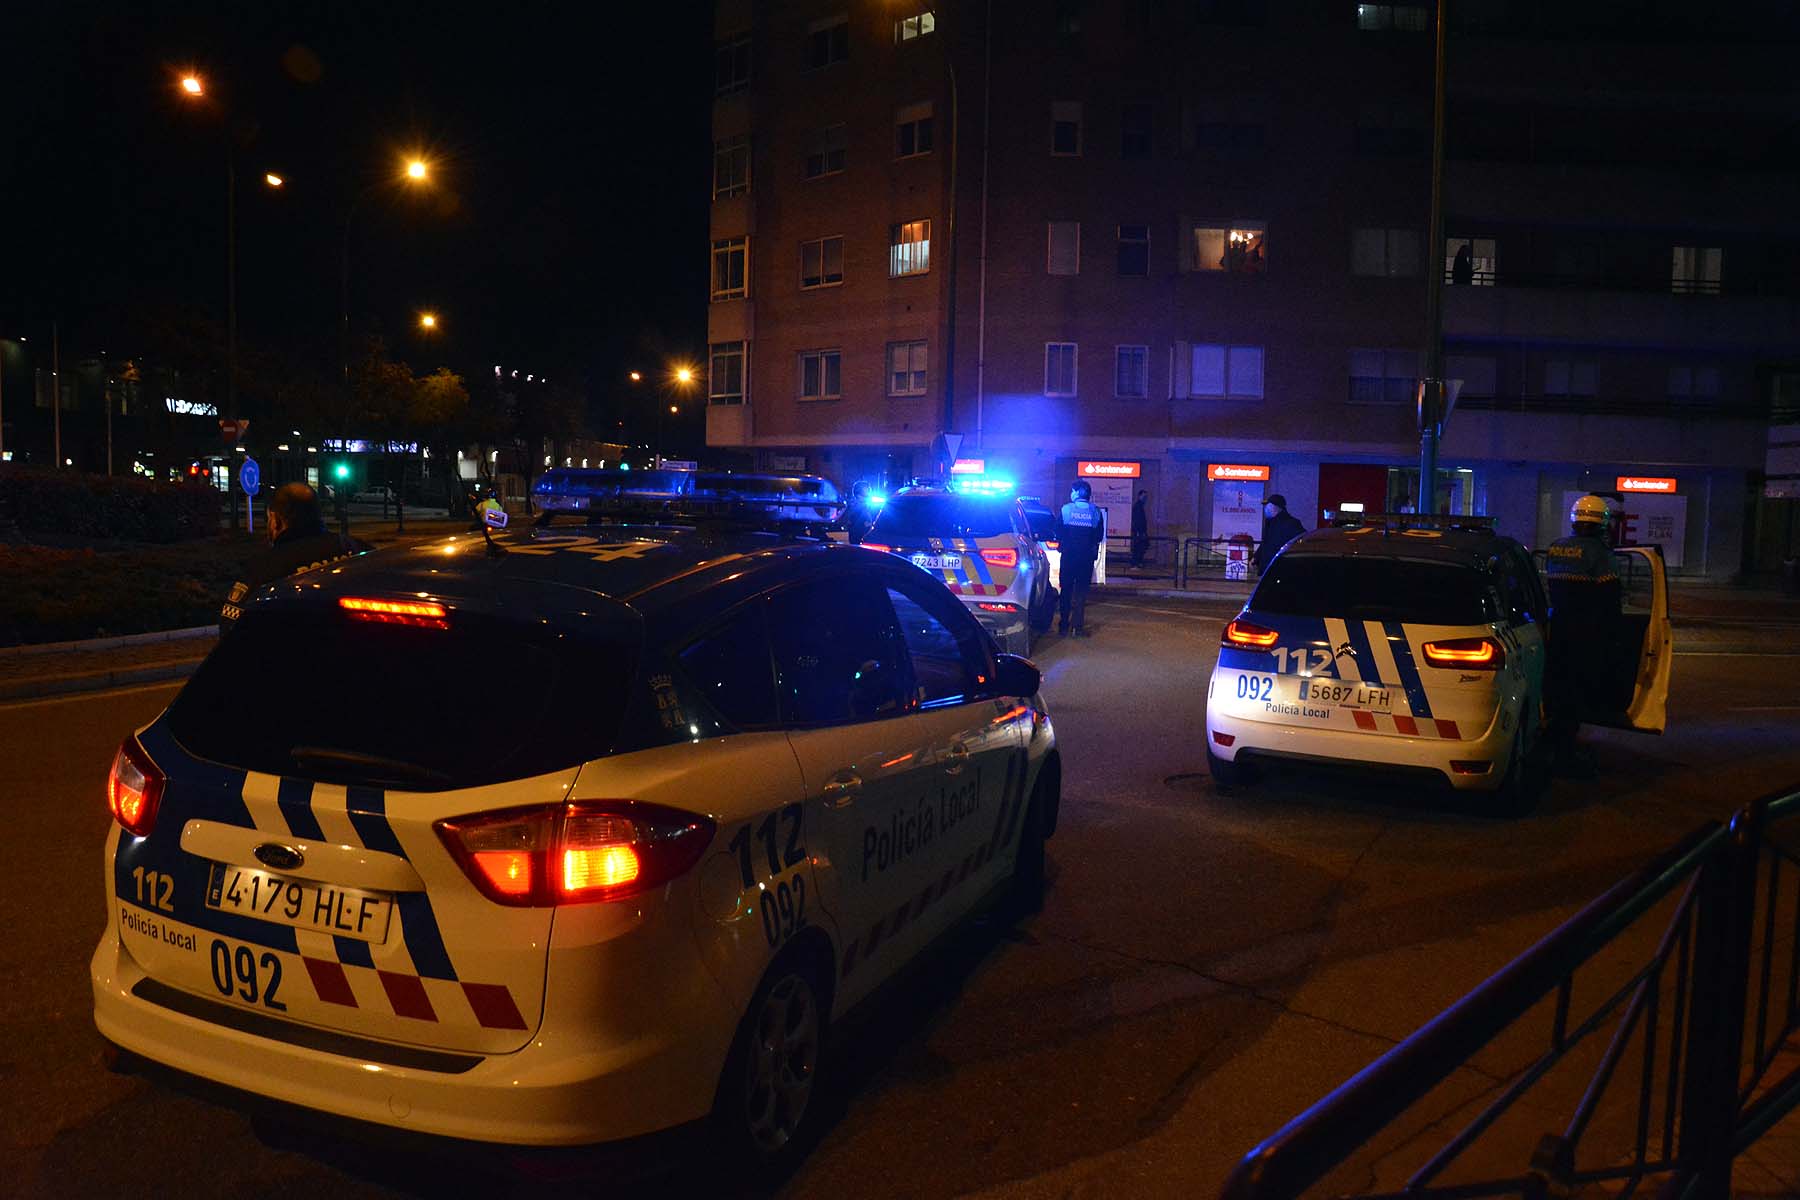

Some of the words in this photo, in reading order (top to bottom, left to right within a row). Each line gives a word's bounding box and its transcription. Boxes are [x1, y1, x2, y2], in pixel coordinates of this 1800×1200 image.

[1095, 464, 1134, 474] Santander
[1225, 467, 1263, 477] Santander
[1632, 480, 1669, 489] Santander
[914, 556, 939, 568] 7243
[941, 557, 961, 568] LHP
[1271, 647, 1333, 677] 112
[1237, 674, 1273, 702] 092
[1311, 684, 1352, 700] 5687
[1357, 691, 1391, 706] LFH
[1303, 706, 1330, 719] Local
[940, 766, 982, 834] Local
[730, 803, 806, 888] 112
[131, 865, 176, 913] 112
[226, 872, 304, 919] 4179
[760, 873, 806, 948] 092
[161, 926, 197, 952] Local
[210, 940, 287, 1012] 092
